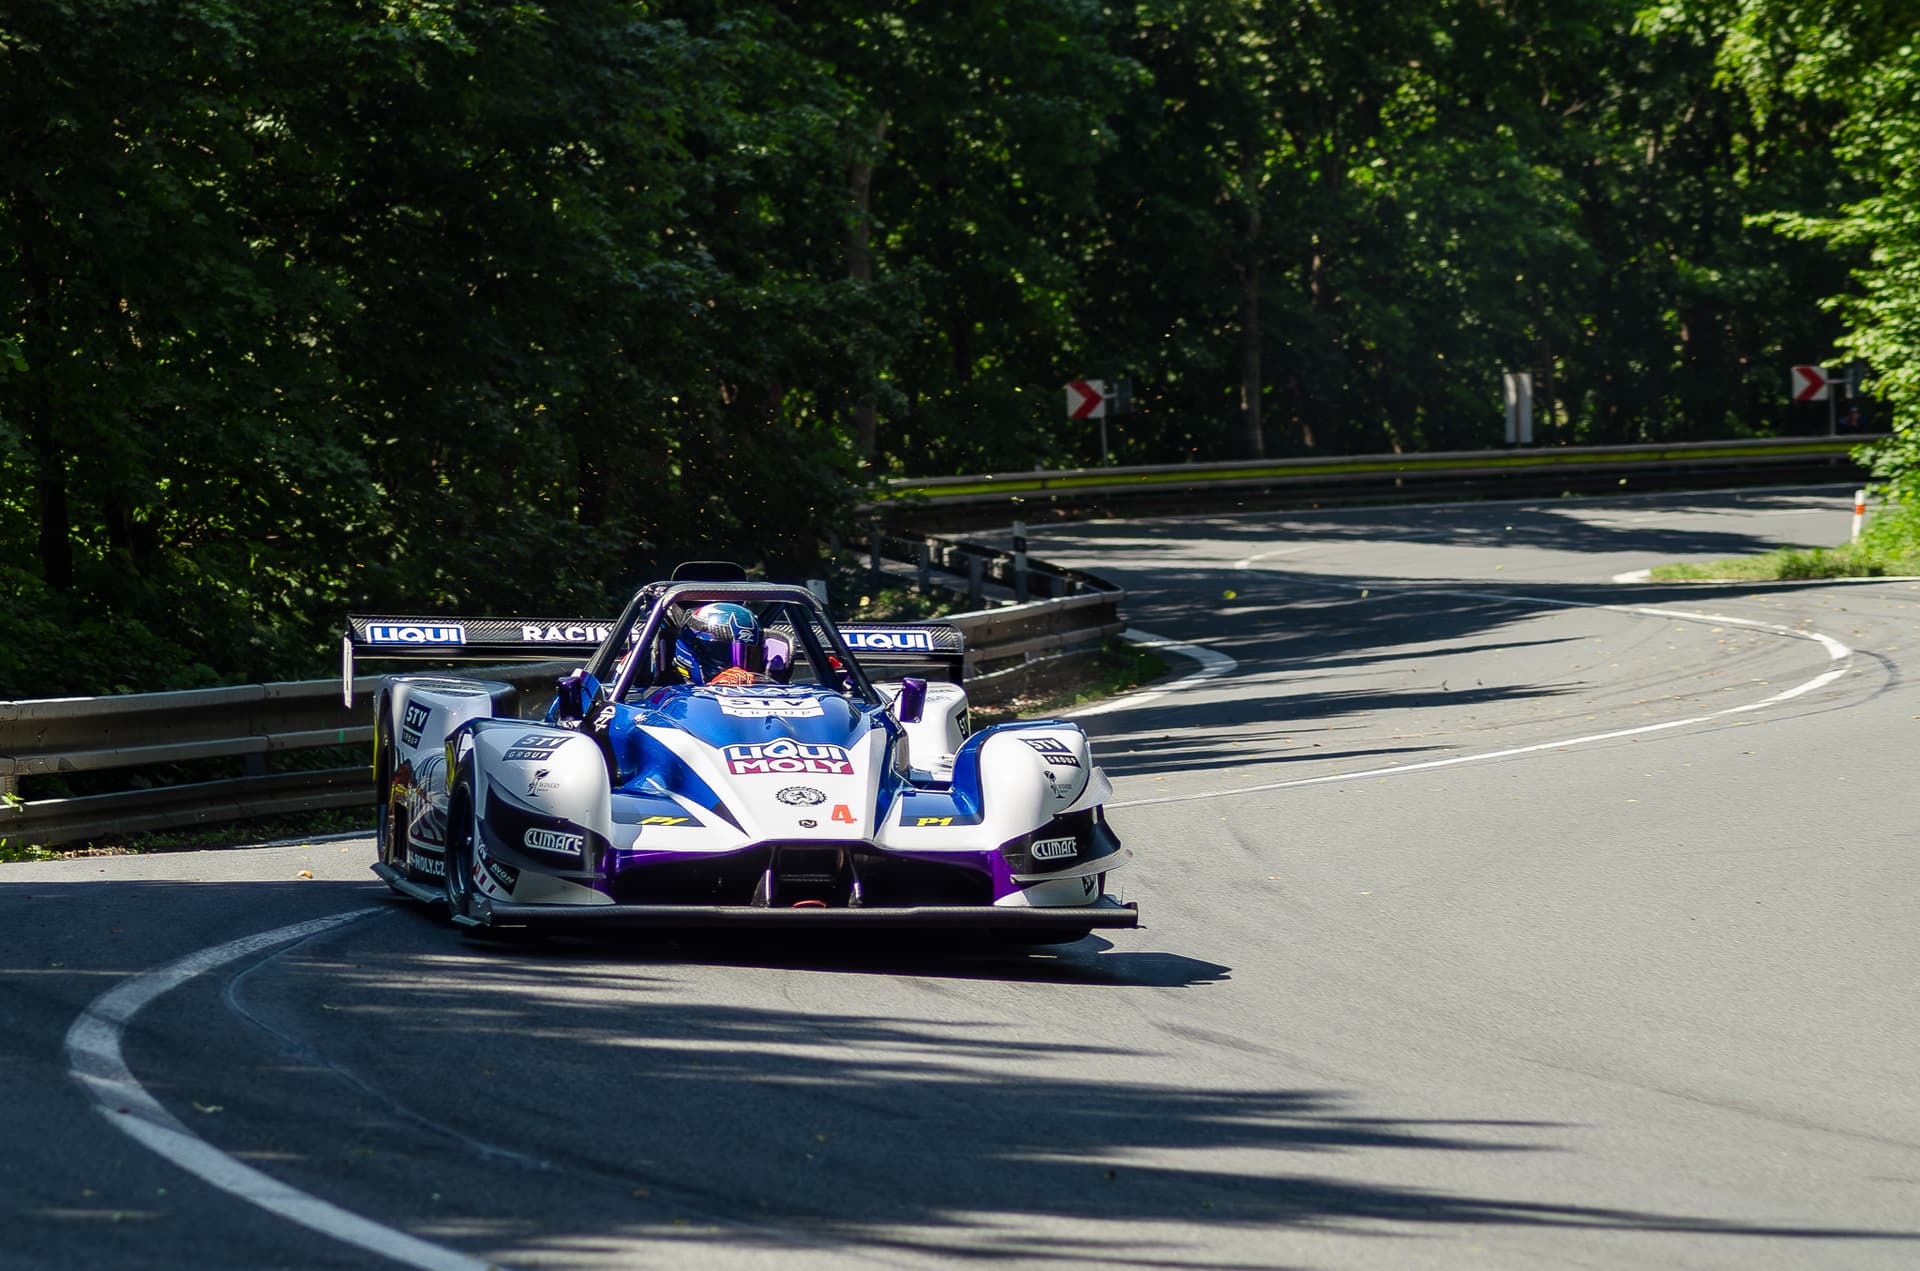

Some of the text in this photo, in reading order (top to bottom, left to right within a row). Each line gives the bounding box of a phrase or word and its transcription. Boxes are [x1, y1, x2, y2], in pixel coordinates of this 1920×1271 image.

[373, 627, 458, 643] LIQUI
[841, 633, 929, 649] LIQUI
[406, 706, 428, 728] STV
[521, 735, 569, 747] STV
[1026, 739, 1064, 751] STV
[508, 751, 548, 760] GROUP
[729, 739, 844, 760] LIQUI
[733, 759, 849, 774] MOLY
[1047, 755, 1077, 765] GROUP
[831, 805, 858, 824] 4
[915, 817, 953, 827] P1
[490, 862, 514, 886] AVON
